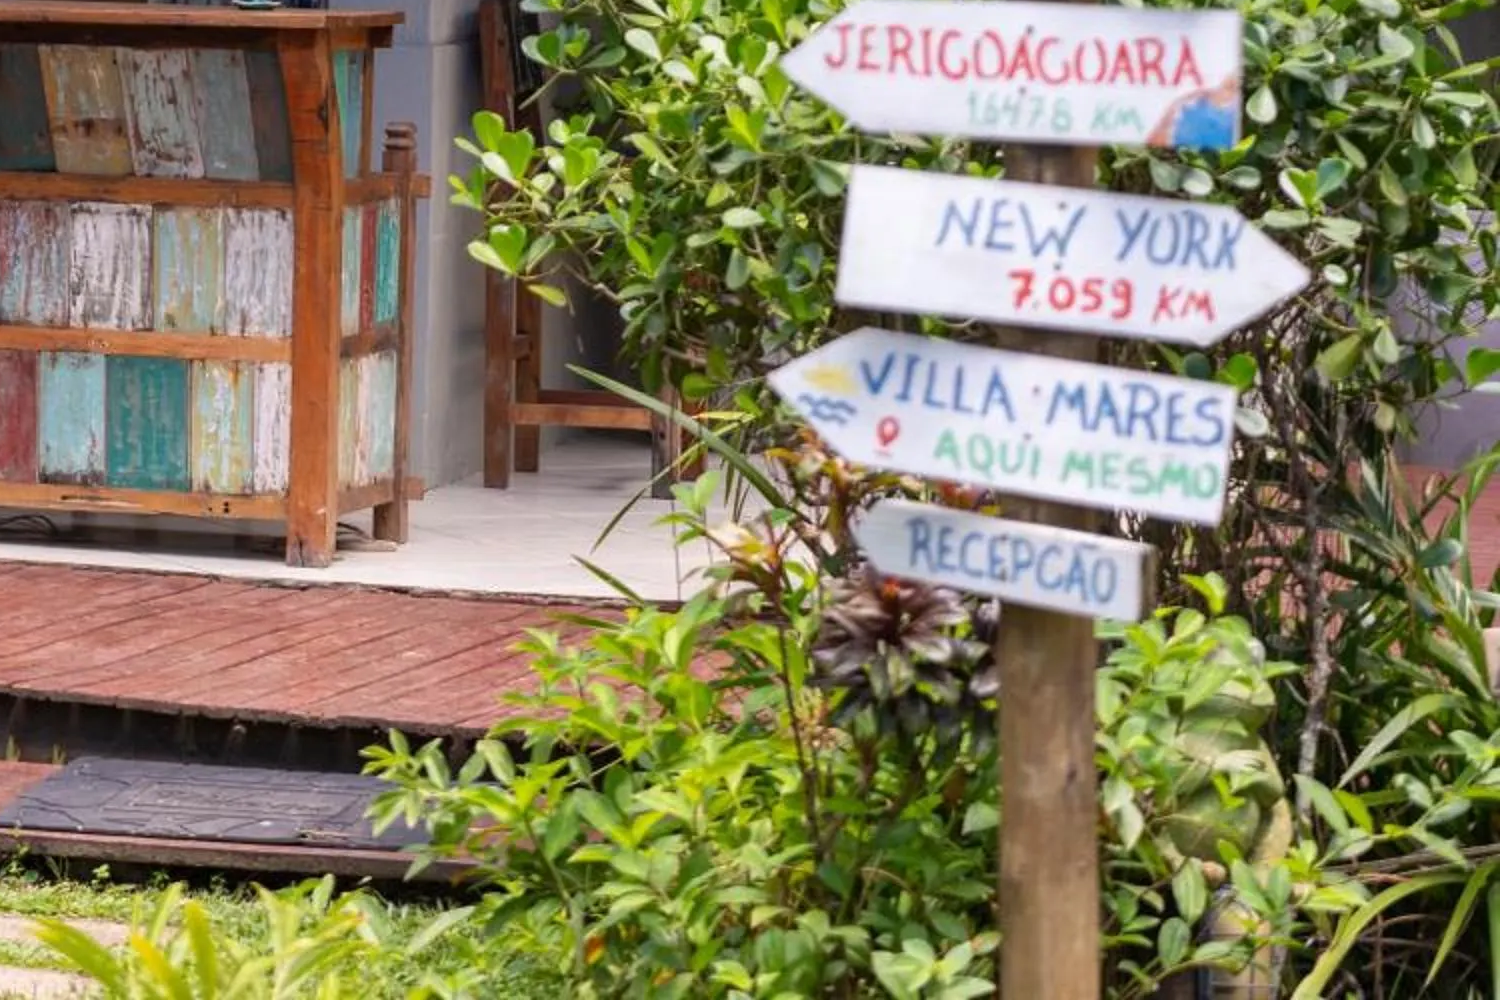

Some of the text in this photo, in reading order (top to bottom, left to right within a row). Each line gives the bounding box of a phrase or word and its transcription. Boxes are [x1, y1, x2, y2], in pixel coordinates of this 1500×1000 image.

[823, 23, 1204, 87] JERICOACOARA
[934, 198, 1244, 271] NEW YORK
[1152, 283, 1218, 324] KM
[858, 351, 1226, 449] VILLA MARES
[932, 427, 1222, 502] AQUI MESMO
